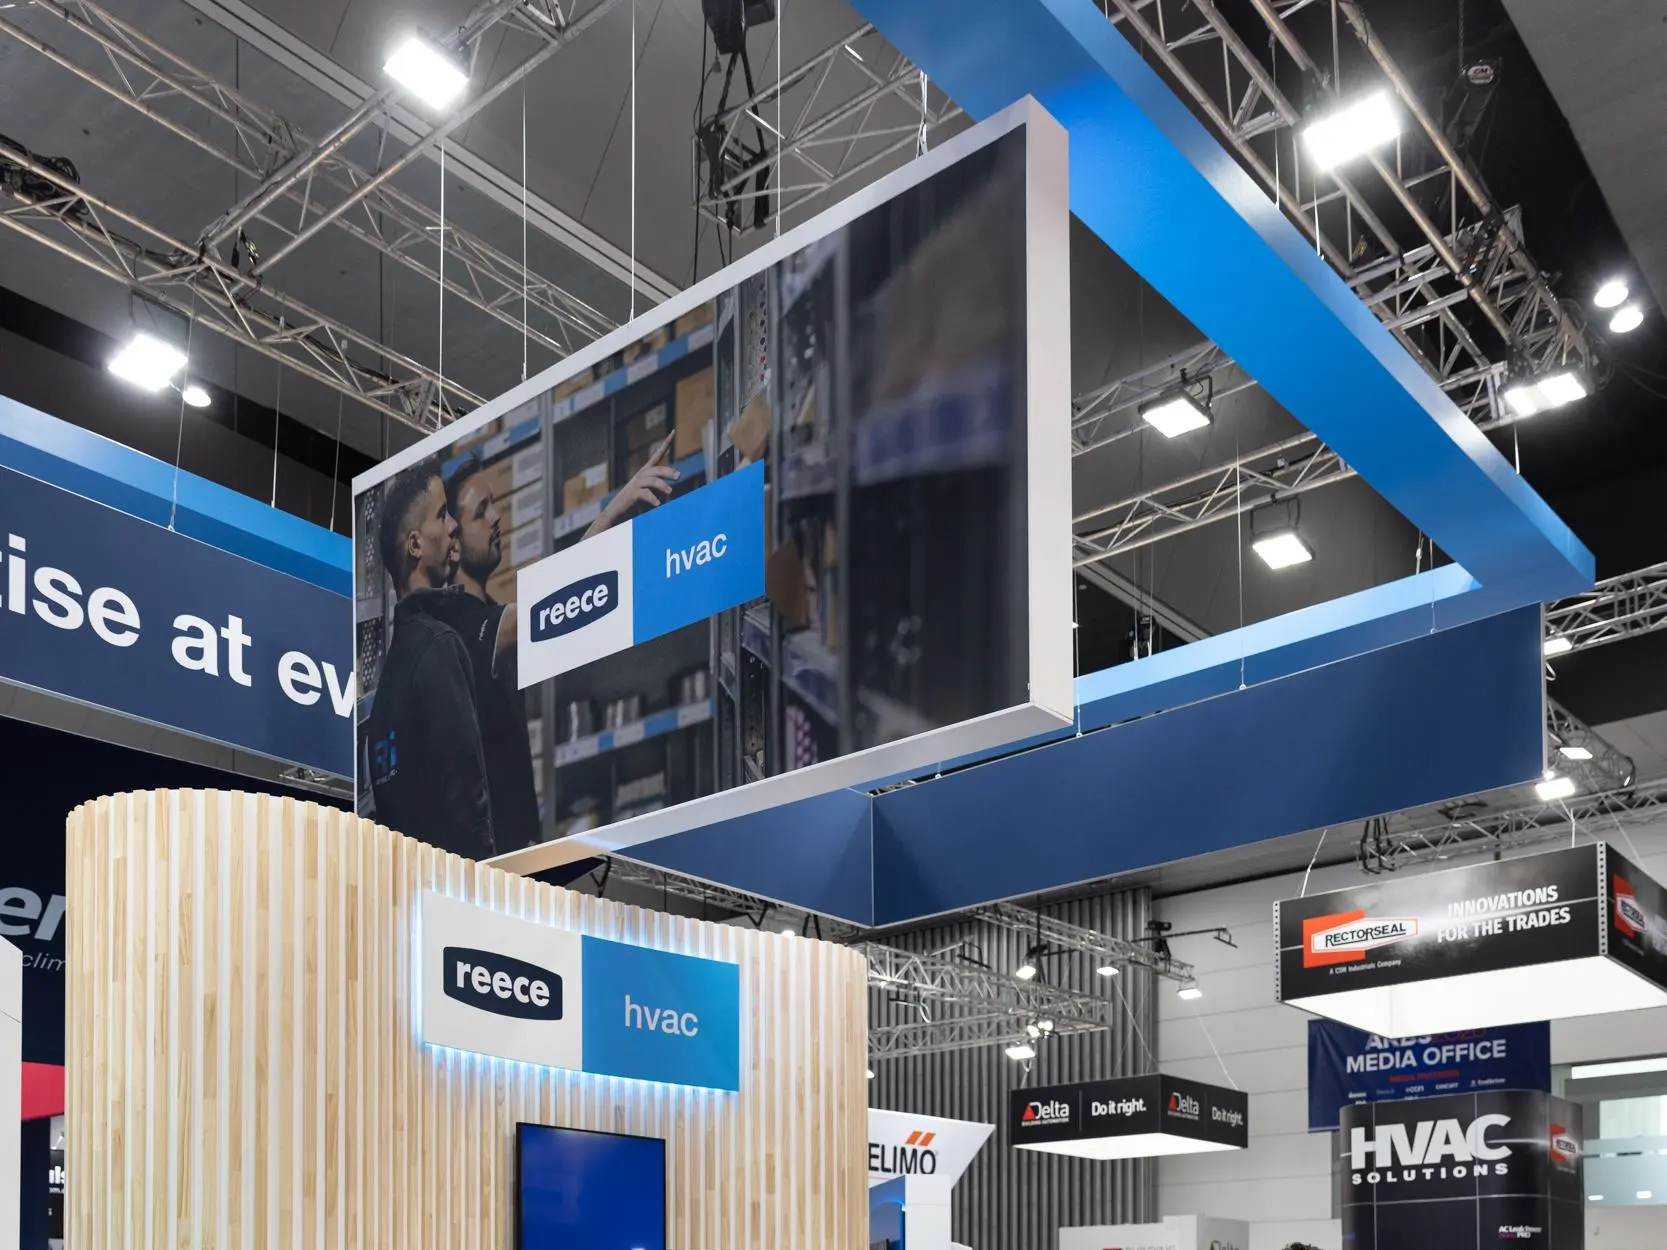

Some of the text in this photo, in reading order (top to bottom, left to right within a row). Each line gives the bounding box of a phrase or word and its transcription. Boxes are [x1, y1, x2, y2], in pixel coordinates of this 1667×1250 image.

[665, 533, 727, 578] hvac
[0, 533, 141, 647] ise
[171, 613, 252, 687] at
[539, 583, 609, 631] reece
[1448, 884, 1559, 917] INNOVATIONS
[1325, 922, 1406, 948] RECTORSEAL
[1437, 906, 1571, 943] FOR THE TRADES
[456, 960, 550, 1007] reece
[624, 994, 698, 1037] hvac
[1346, 1039, 1507, 1074] MEDIA OFFICE
[1022, 1099, 1070, 1121] Delta
[1091, 1098, 1147, 1117] Do it right.
[1168, 1092, 1200, 1115] Delta
[1351, 1113, 1513, 1170] HVAC
[1351, 1163, 1510, 1185] SOLUTIONS
